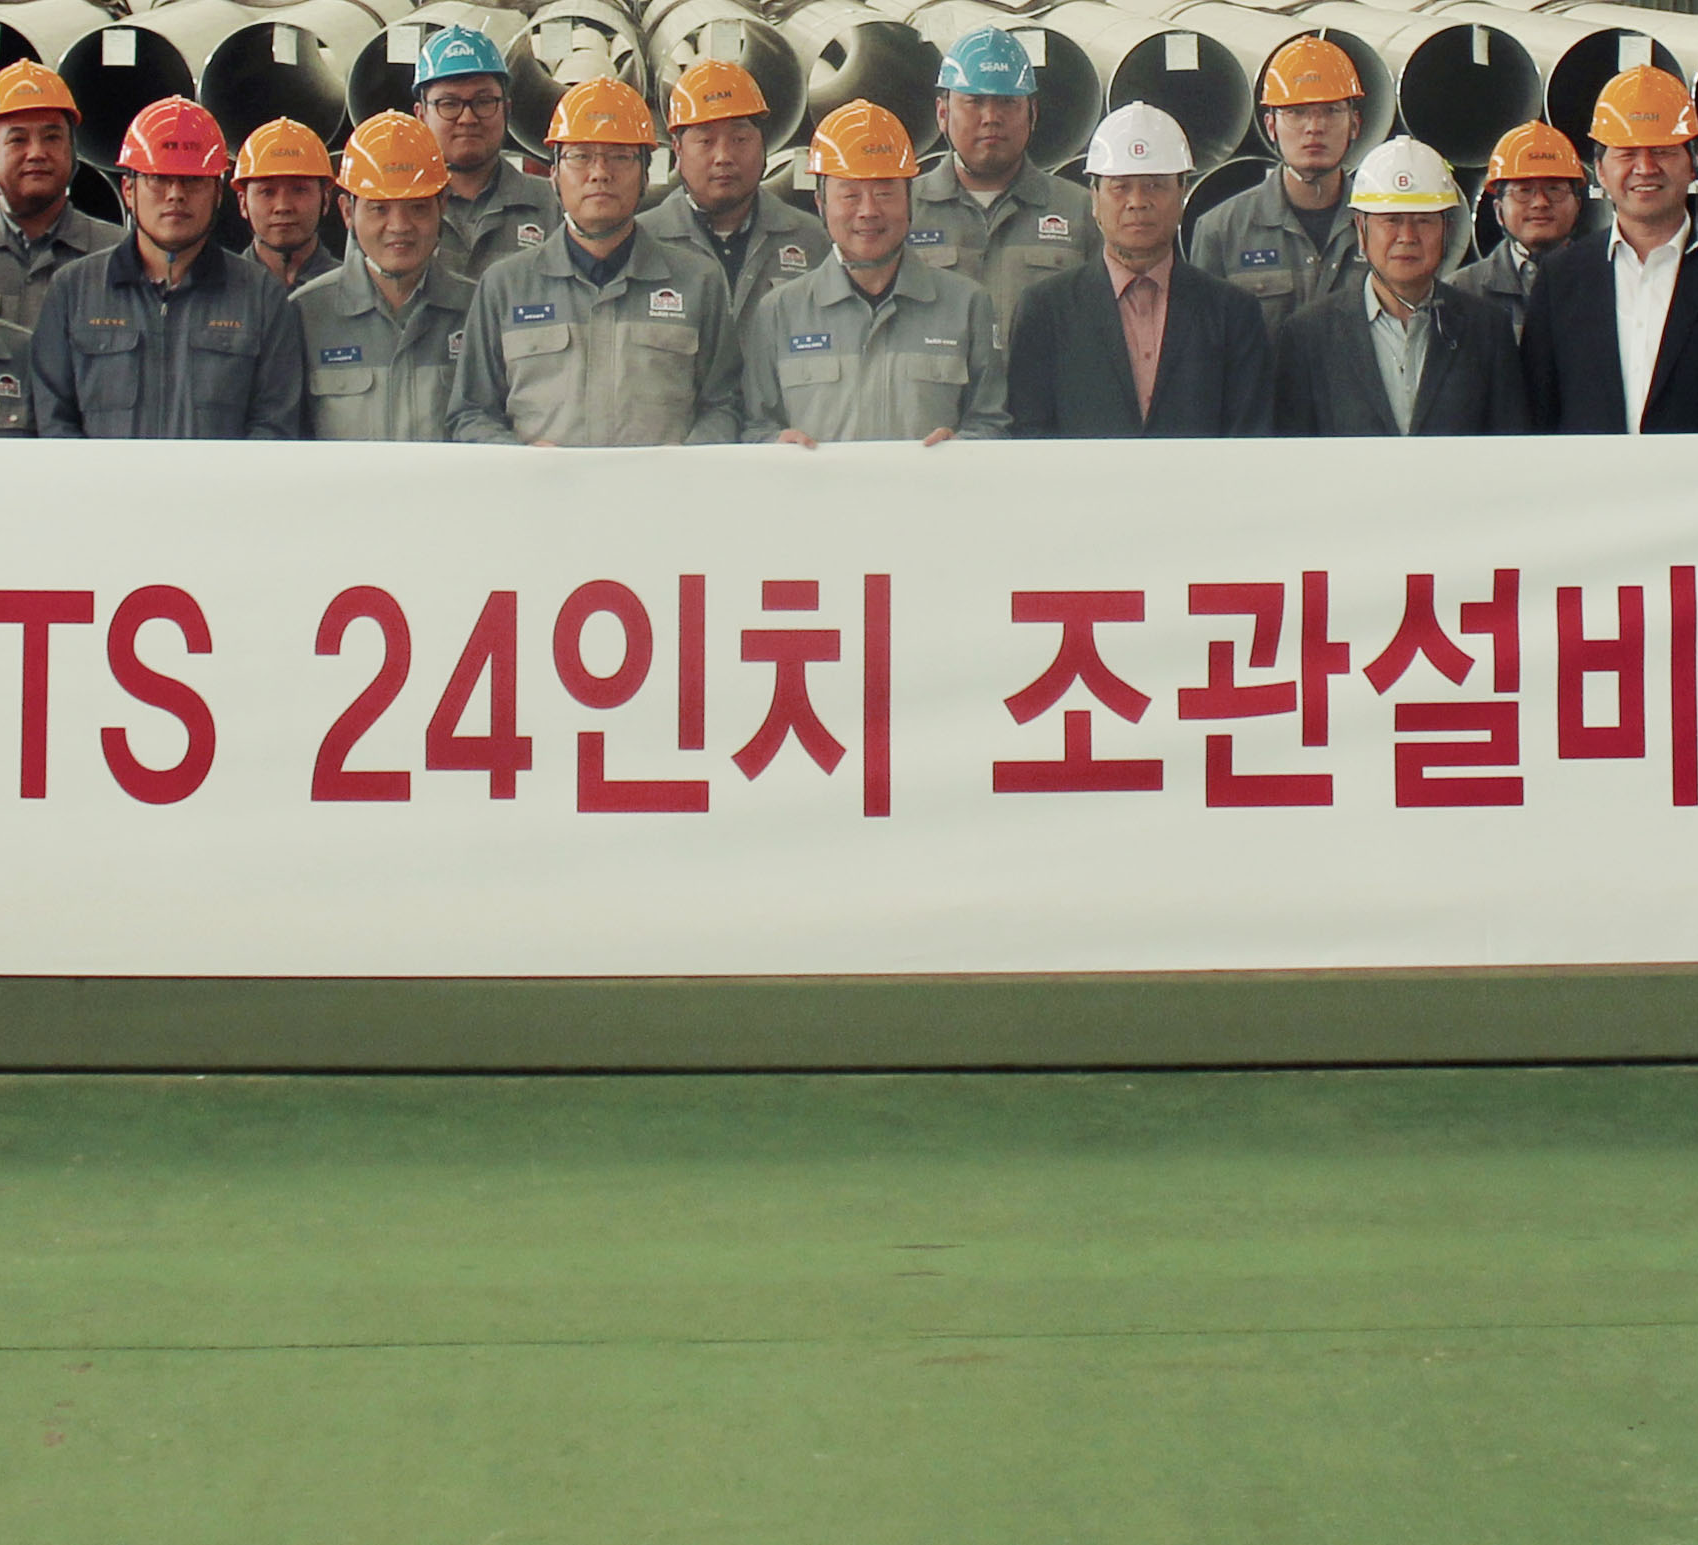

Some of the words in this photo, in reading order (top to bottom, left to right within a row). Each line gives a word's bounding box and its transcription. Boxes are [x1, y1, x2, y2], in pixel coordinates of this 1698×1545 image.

[445, 46, 475, 58] SeAH
[979, 62, 1010, 73] SeAH
[311, 573, 891, 817] 24인치
[993, 565, 1698, 808] 조관설비
